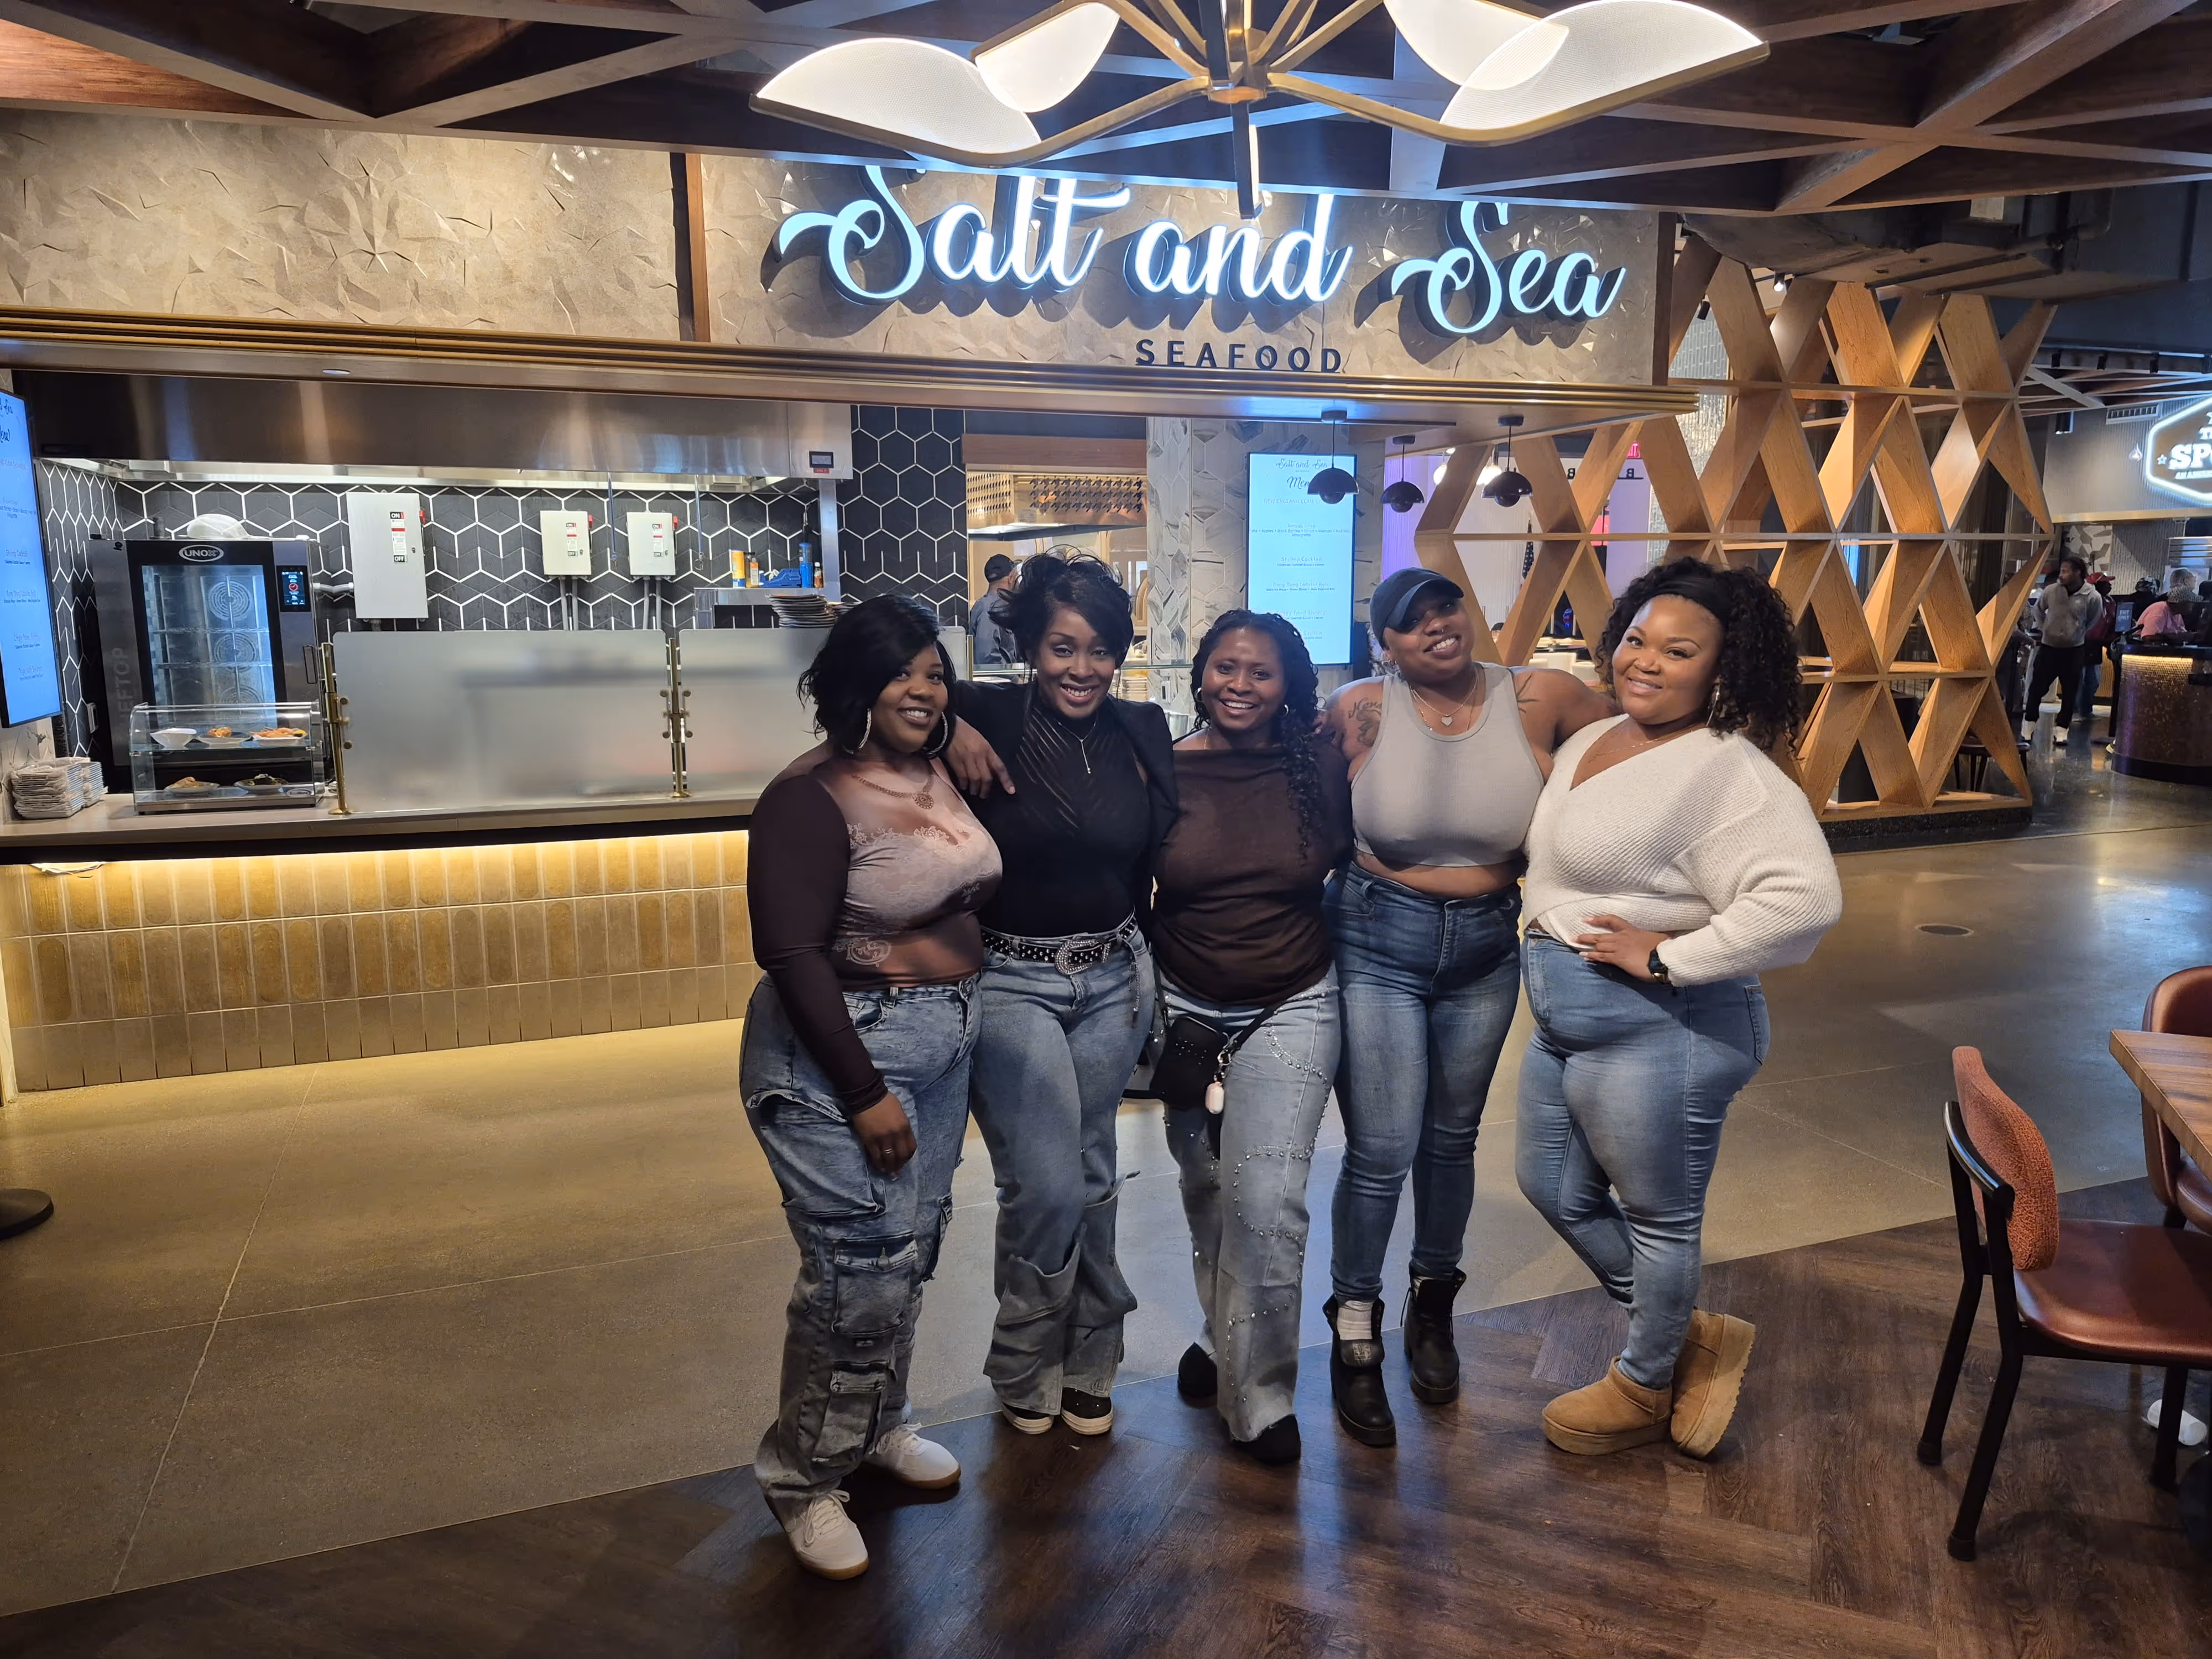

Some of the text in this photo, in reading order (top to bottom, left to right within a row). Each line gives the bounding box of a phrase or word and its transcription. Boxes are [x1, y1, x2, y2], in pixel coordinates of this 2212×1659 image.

[779, 165, 1626, 333] Salt and Sea
[1136, 339, 1341, 373] SEAFOOD
[1276, 458, 1295, 469] Salt
[1296, 460, 1310, 468] and
[2168, 443, 2212, 469] SP
[1287, 476, 1310, 489] Men
